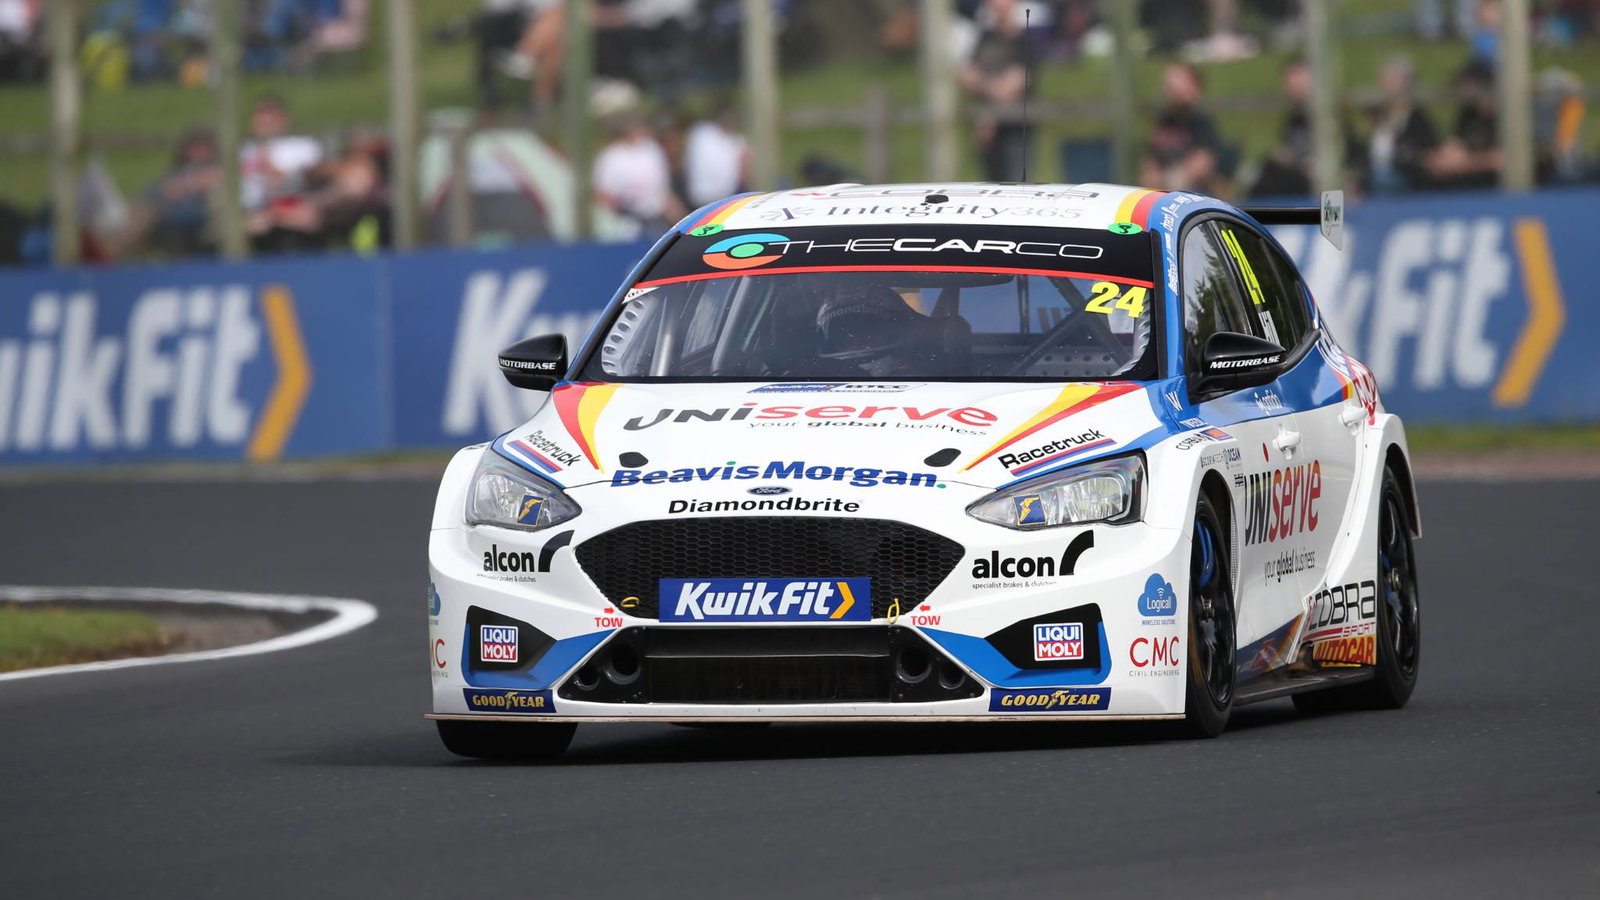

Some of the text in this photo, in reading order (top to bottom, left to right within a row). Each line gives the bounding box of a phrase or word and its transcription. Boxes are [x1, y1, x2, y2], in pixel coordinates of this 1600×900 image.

[1085, 281, 1147, 318] 24
[500, 357, 556, 370] MOTORBASE
[1210, 355, 1280, 369] MOTORBASE
[807, 420, 887, 428] global
[895, 422, 987, 436] business
[525, 429, 581, 466] Racetruck
[998, 428, 1106, 469] Racetruck
[668, 496, 860, 514] Diamondbrite
[483, 543, 535, 573] alcon
[972, 550, 1055, 579] alcon
[1264, 549, 1316, 587] your global business
[972, 582, 1002, 590] specialist
[1147, 597, 1172, 613] Logical
[595, 617, 623, 628] TOW
[911, 615, 941, 626] TOW
[483, 629, 515, 644] LIQUI
[1038, 626, 1080, 642] LIQUI
[484, 645, 516, 659] MOLY
[1038, 641, 1081, 658] MOLY
[1129, 636, 1179, 668] CMC
[1314, 638, 1375, 664] AUTOCAR
